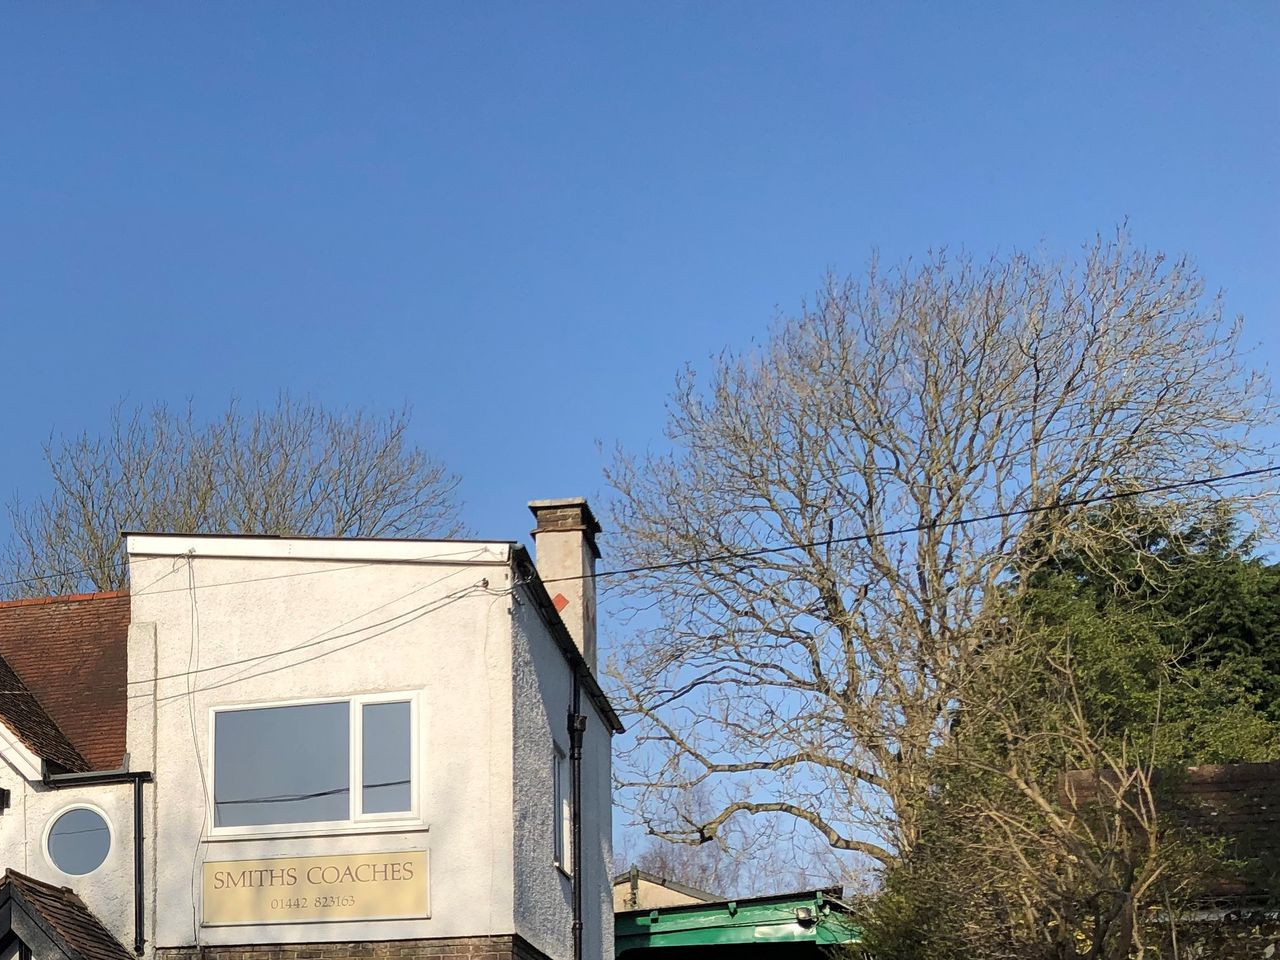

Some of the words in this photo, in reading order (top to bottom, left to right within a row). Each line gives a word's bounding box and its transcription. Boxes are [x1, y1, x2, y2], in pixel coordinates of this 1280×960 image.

[214, 868, 297, 889] SMITHS
[307, 862, 414, 885] COACHES
[271, 898, 308, 910] 01442
[314, 895, 356, 908] 823163
